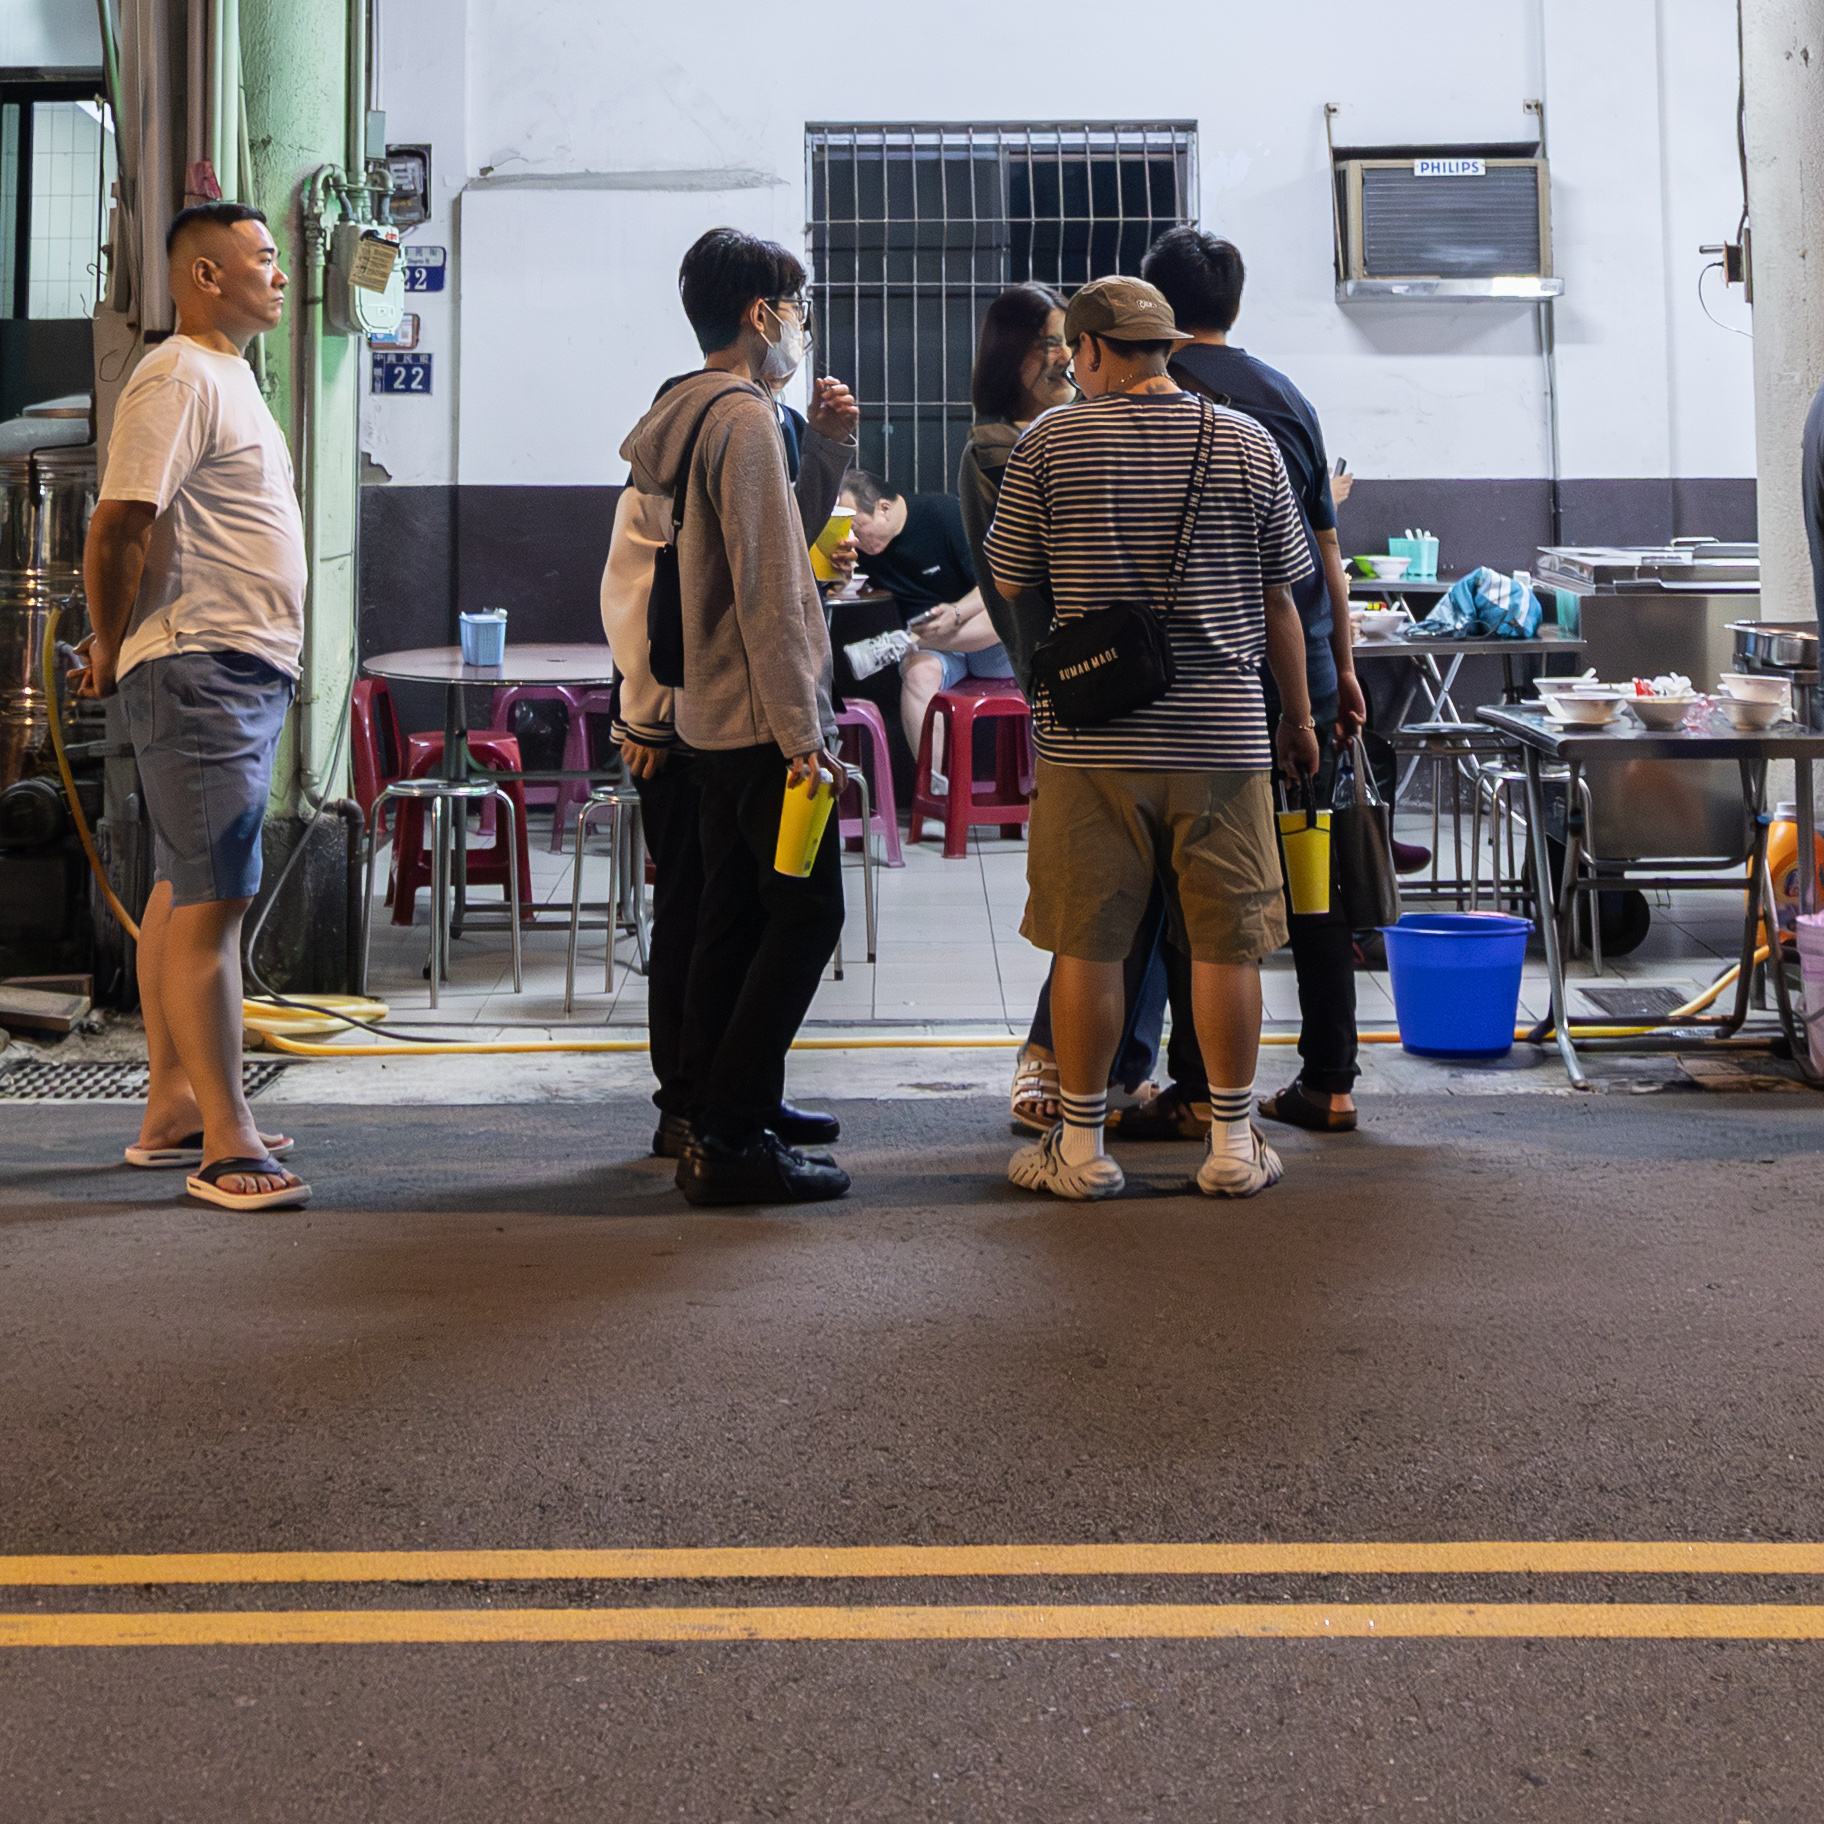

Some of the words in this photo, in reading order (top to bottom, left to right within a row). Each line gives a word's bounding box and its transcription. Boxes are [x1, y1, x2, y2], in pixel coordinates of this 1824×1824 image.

[1420, 161, 1480, 173] PHILIPS
[404, 267, 427, 290] 22
[393, 366, 424, 390] 22
[1091, 647, 1118, 669] MADE
